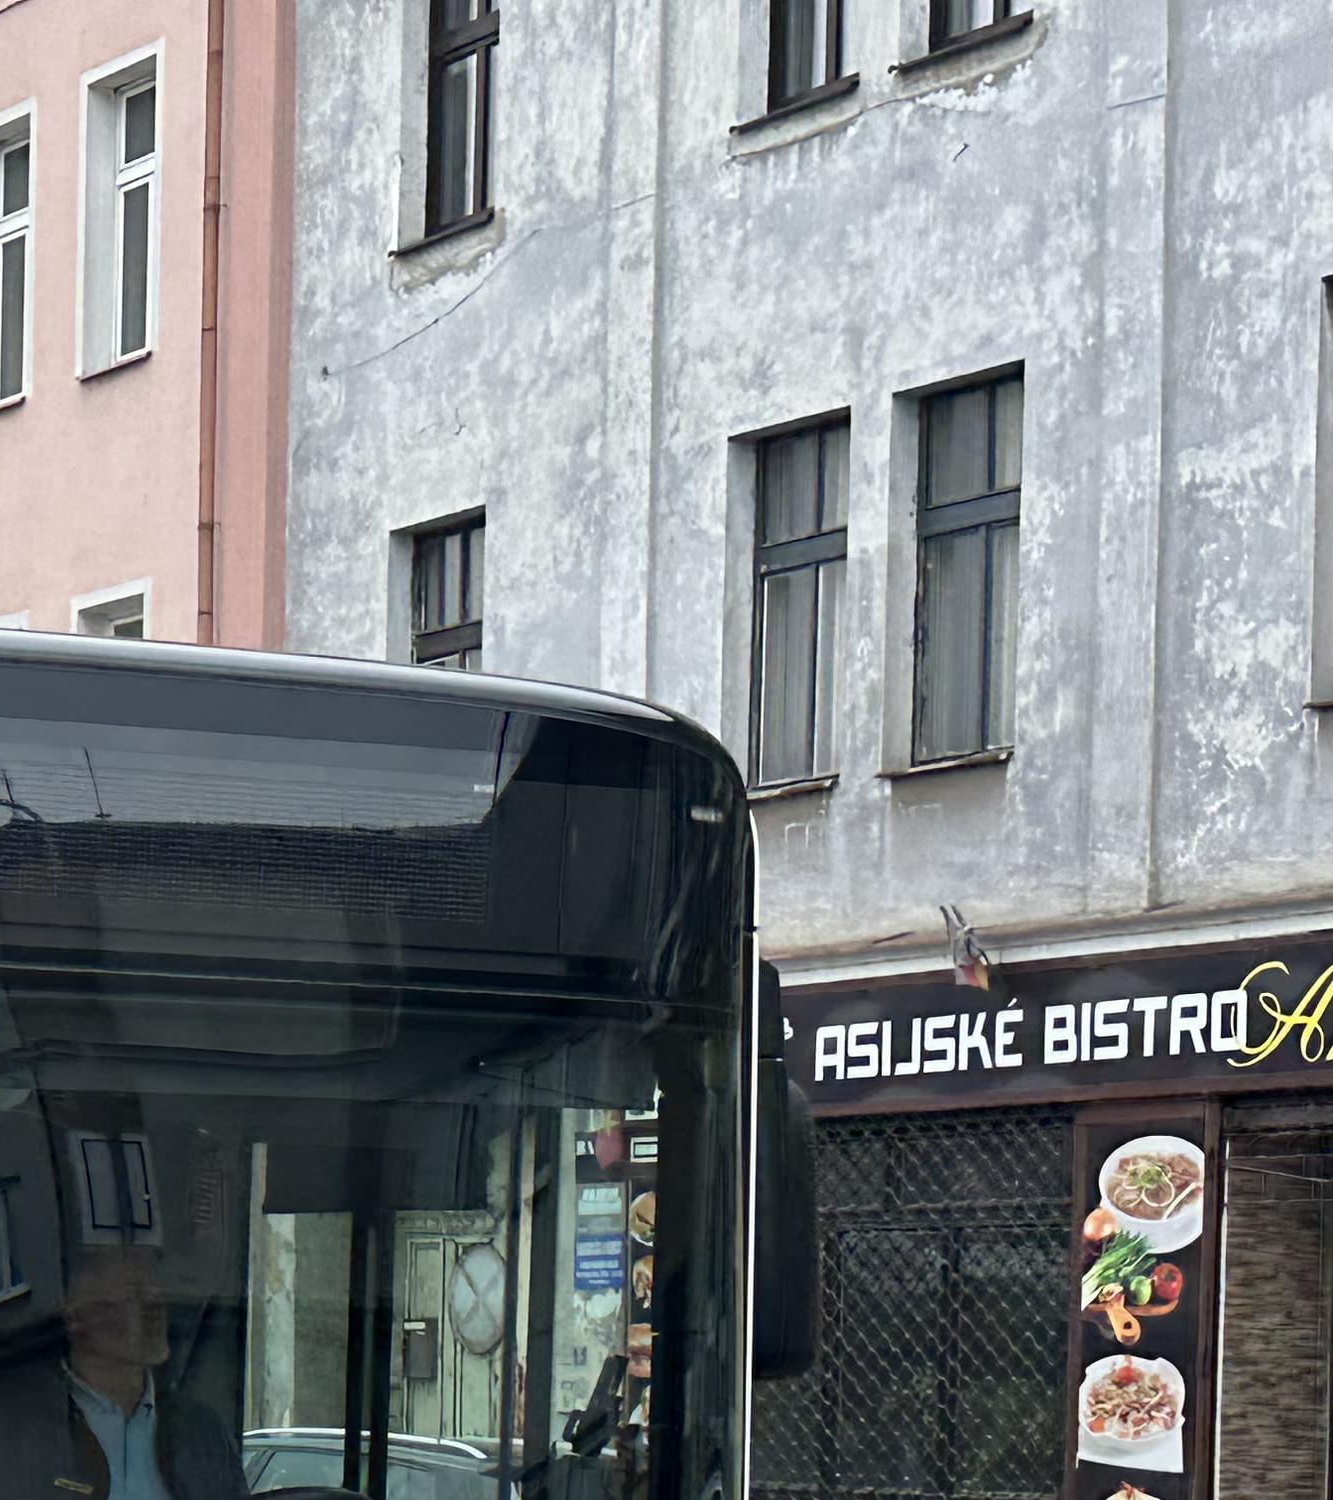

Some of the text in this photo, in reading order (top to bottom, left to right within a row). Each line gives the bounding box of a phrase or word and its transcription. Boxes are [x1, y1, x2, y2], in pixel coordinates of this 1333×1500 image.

[814, 989, 1247, 1081] ASIJSKÉ BISTRO
[1227, 960, 1333, 1068] A
